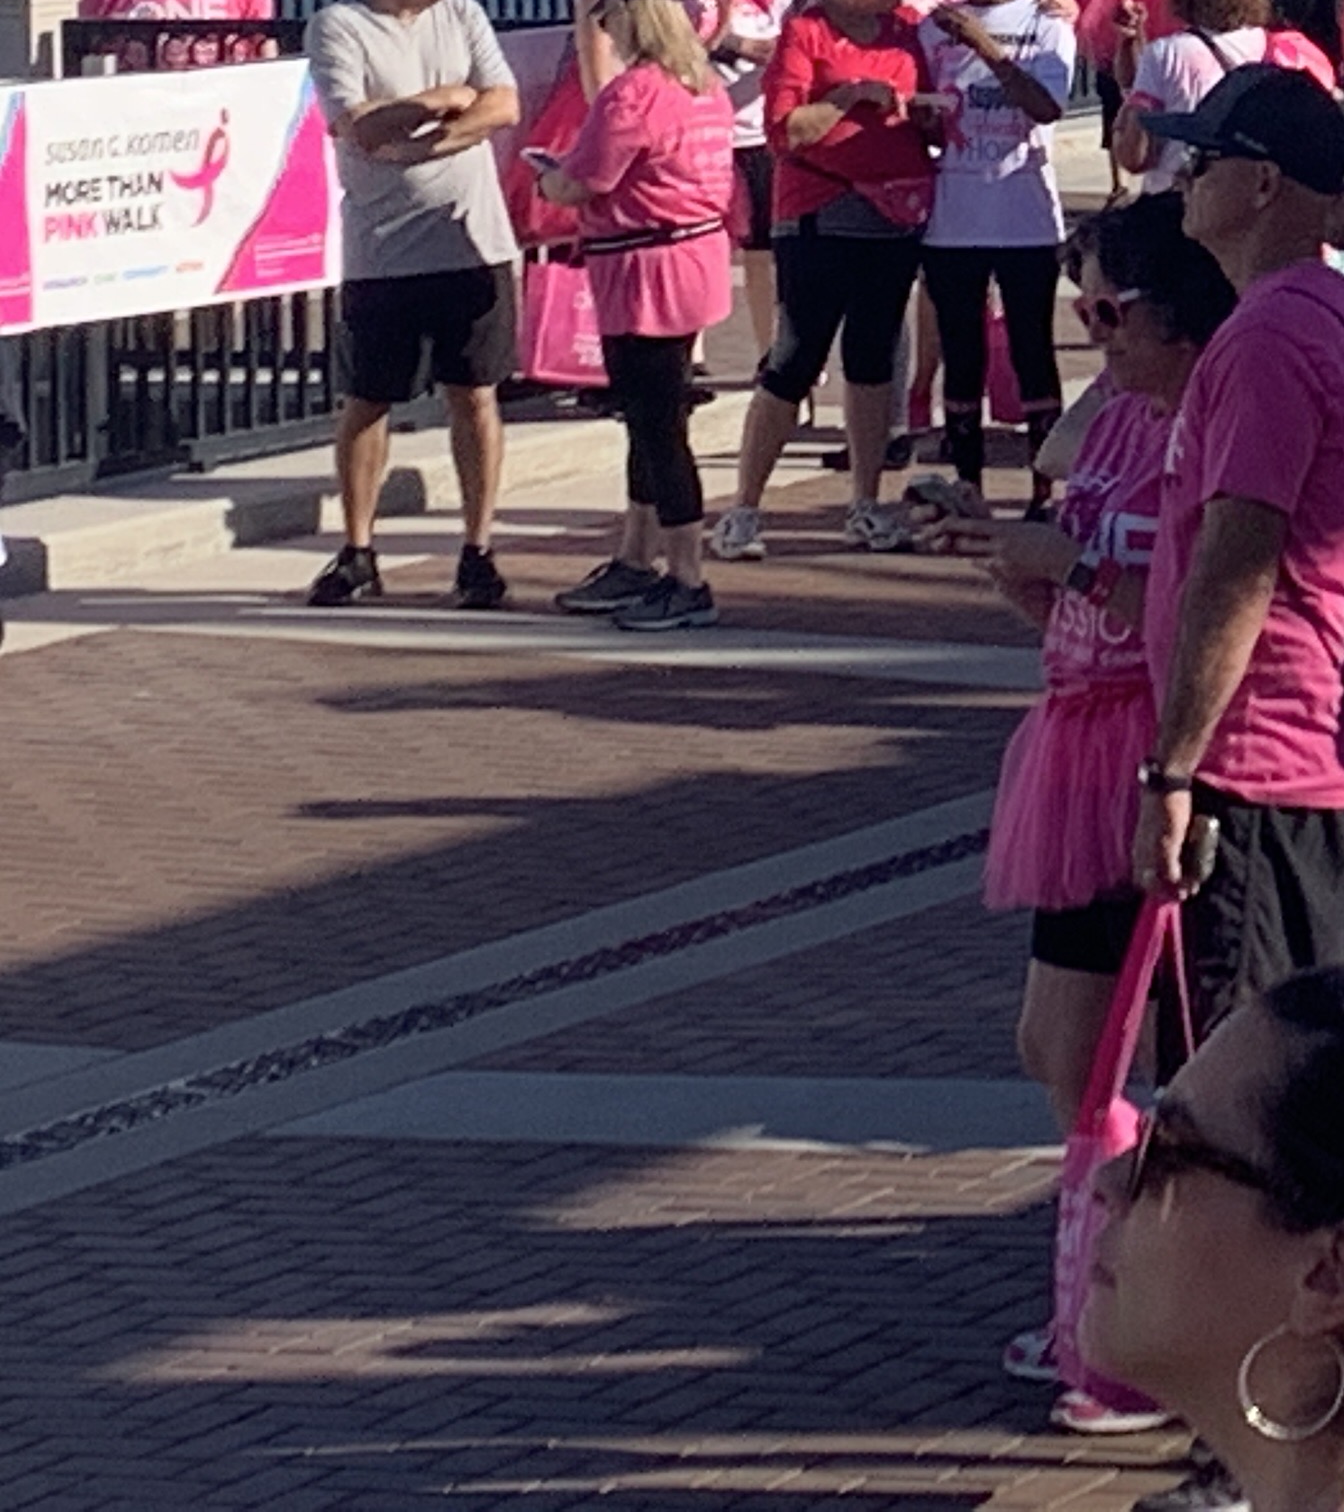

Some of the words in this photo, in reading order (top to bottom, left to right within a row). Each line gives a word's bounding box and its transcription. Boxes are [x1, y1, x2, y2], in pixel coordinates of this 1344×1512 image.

[45, 178, 102, 208] MORE
[107, 171, 164, 198] THAN
[45, 212, 98, 243] PINK
[103, 203, 163, 235] WALK
